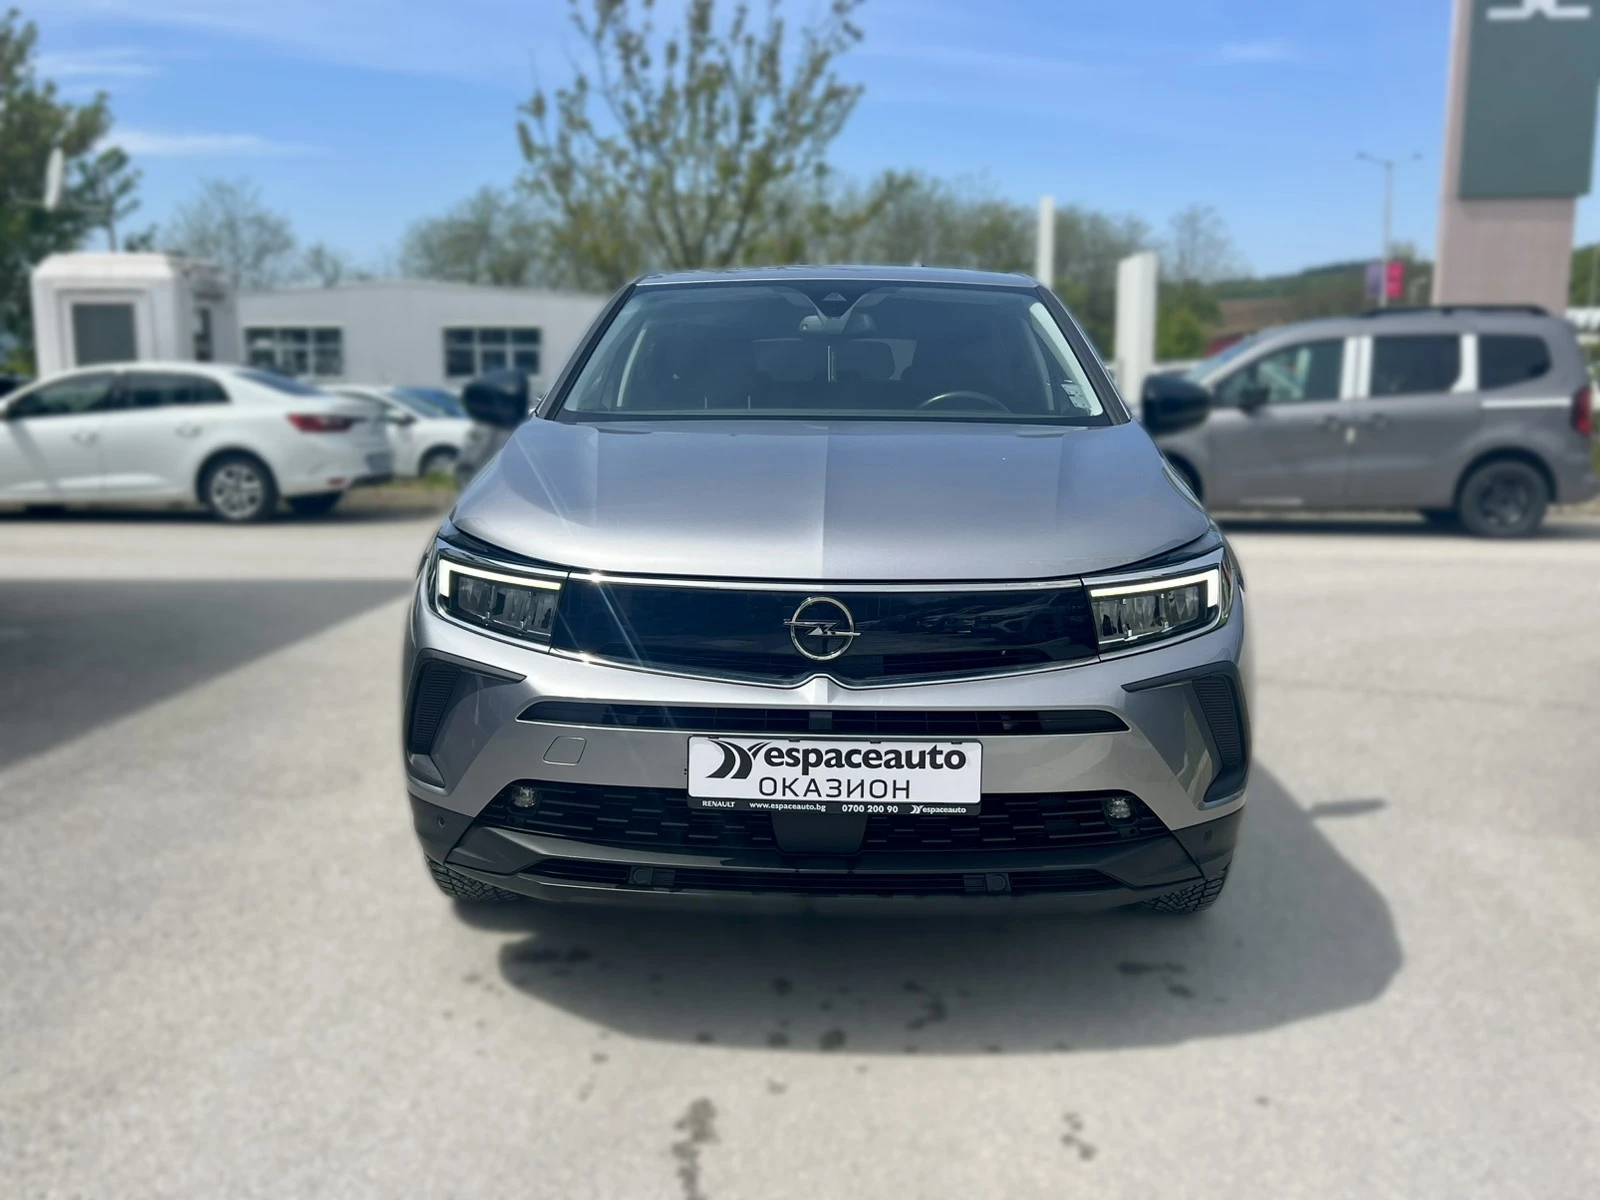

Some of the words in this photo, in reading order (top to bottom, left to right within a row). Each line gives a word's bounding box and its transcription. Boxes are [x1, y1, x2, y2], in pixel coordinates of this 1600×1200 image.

[764, 744, 967, 775] espaceauto
[758, 776, 910, 799] ОКАЗИОН
[702, 800, 735, 808] RENAULT
[749, 802, 827, 812] www.espaceauto.bg
[841, 804, 865, 813] 0700
[867, 805, 884, 813] 200
[887, 805, 899, 814] 90
[922, 806, 967, 815] espaceauto
